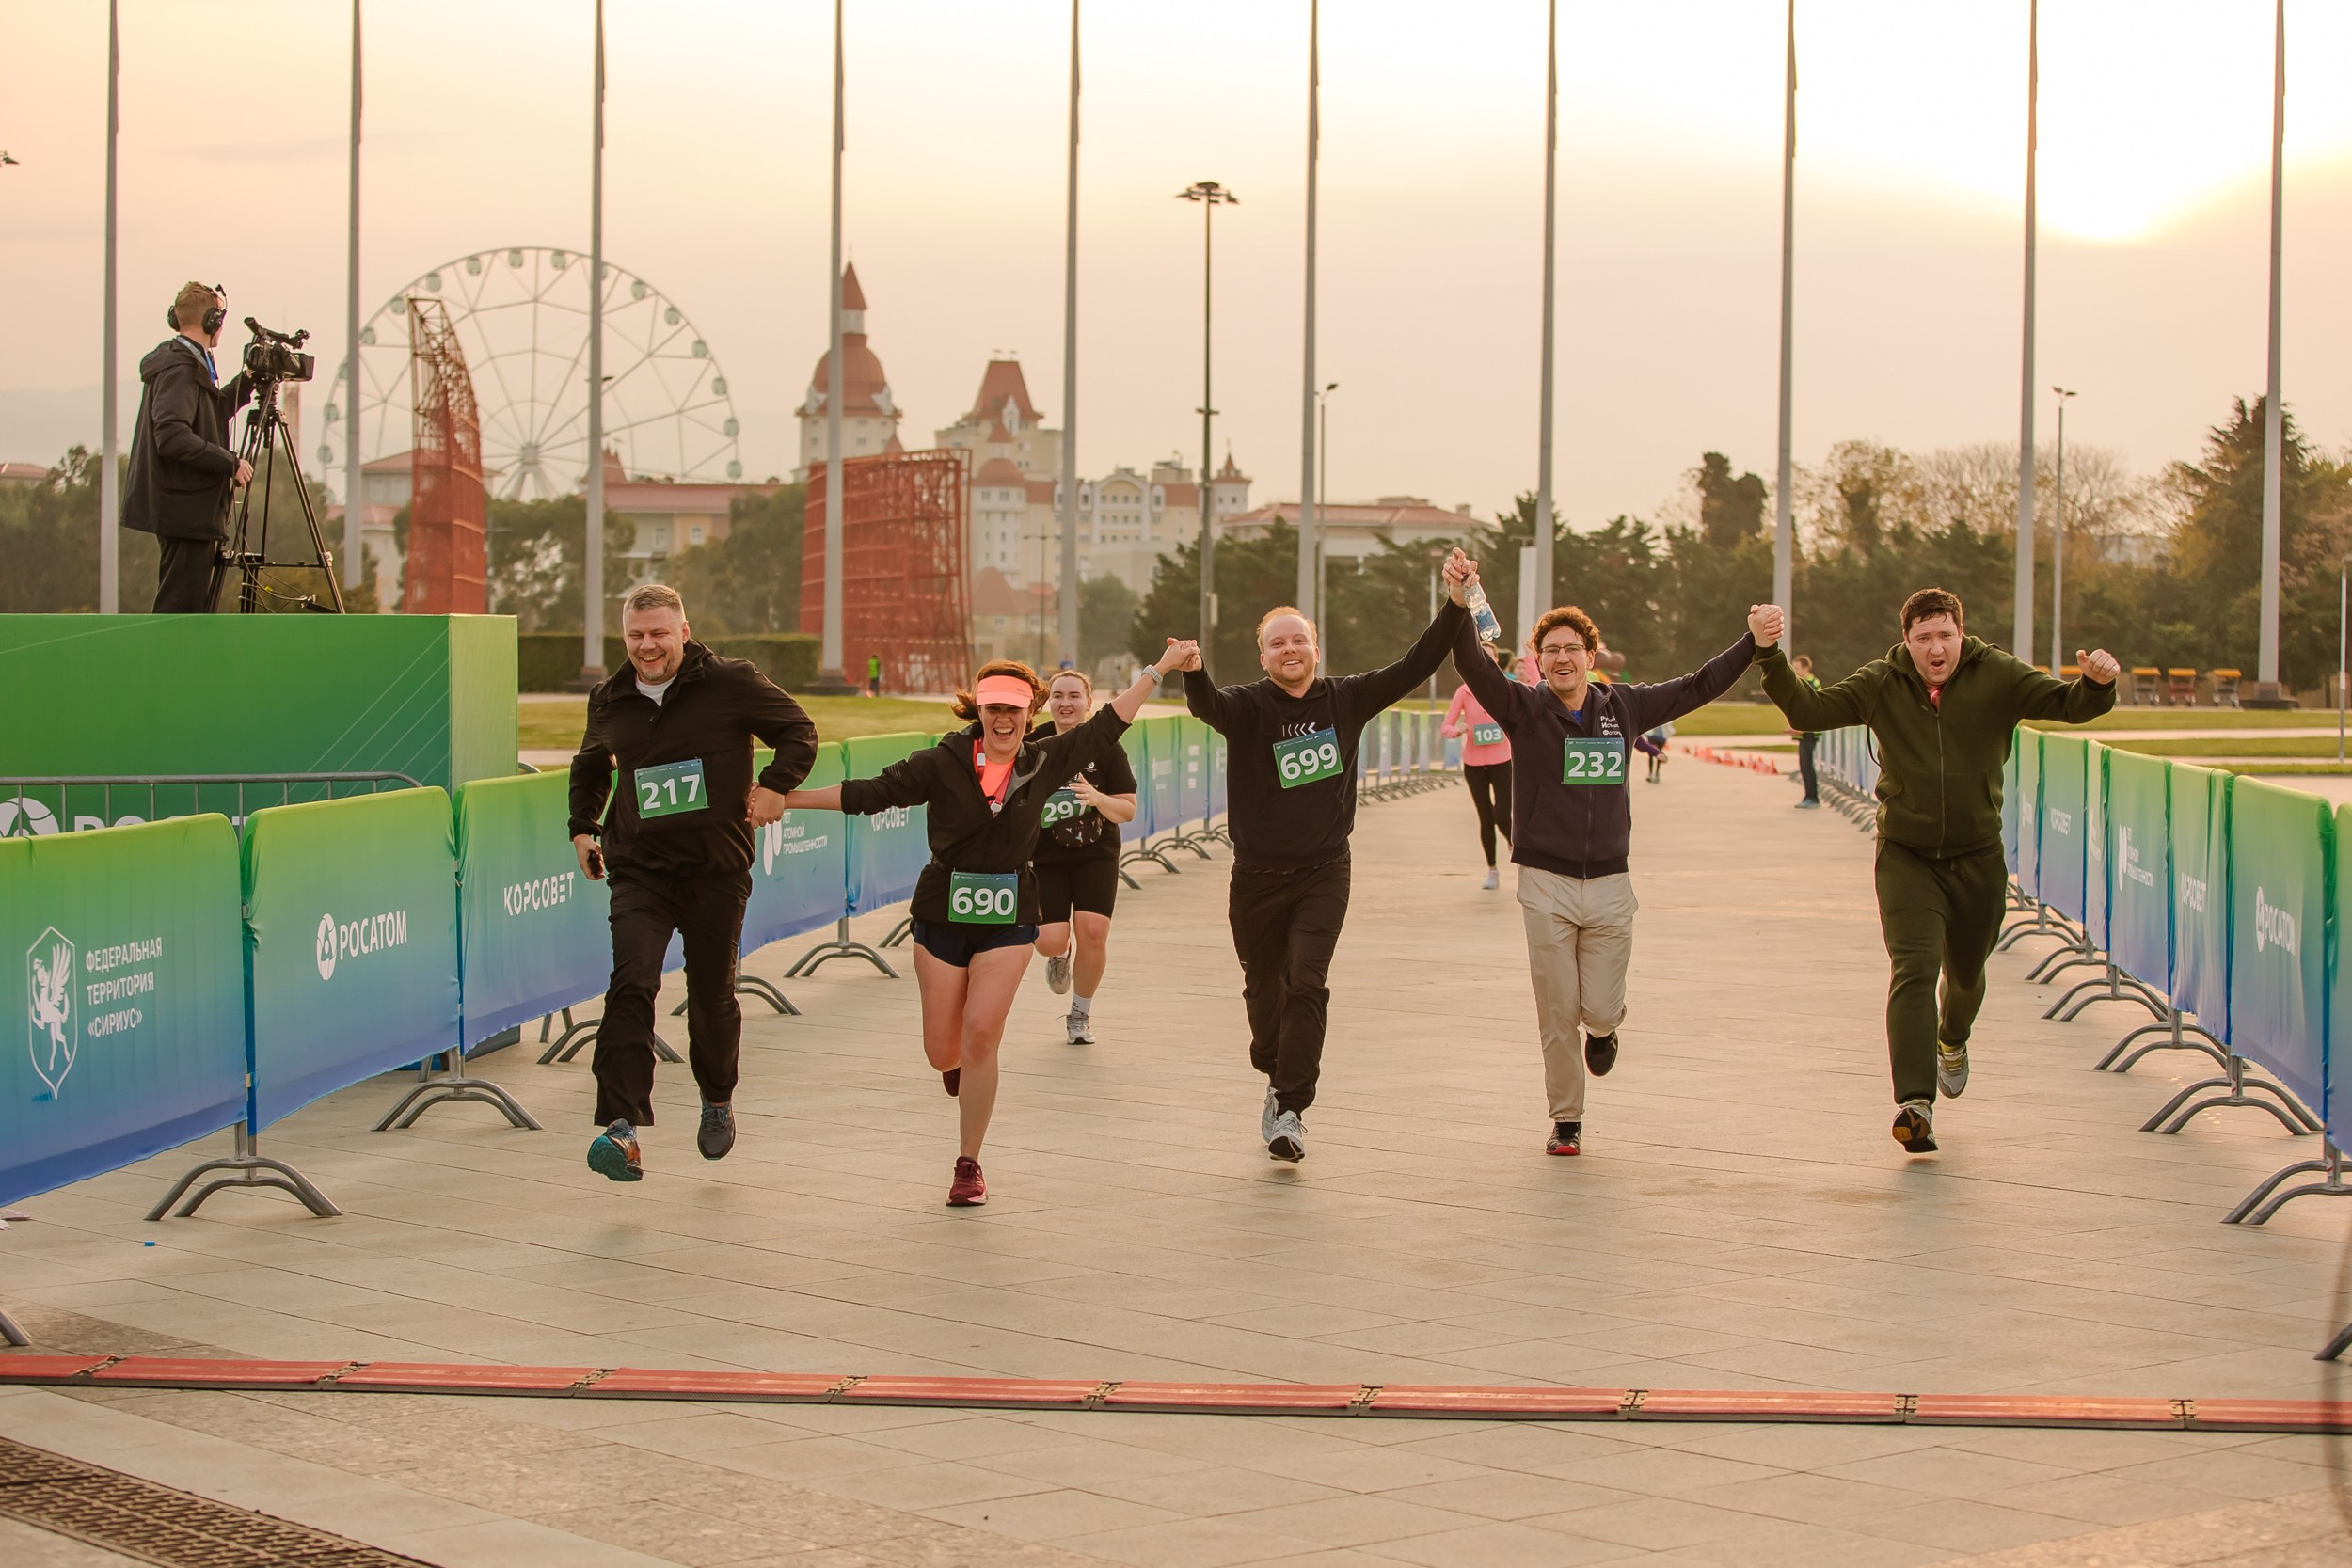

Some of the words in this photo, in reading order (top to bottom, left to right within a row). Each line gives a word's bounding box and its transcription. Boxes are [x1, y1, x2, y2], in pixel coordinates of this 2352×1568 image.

[1474, 728, 1502, 742] 103
[1280, 743, 1338, 780] 699
[1567, 751, 1622, 778] 232
[641, 774, 700, 810] 217
[1043, 799, 1088, 823] 297
[503, 871, 575, 916] КОРСОВЕТ
[952, 887, 1015, 916] 690
[340, 910, 407, 960] РОСАТОМ
[86, 937, 162, 973] ФЕДЕРАЛЬНАЯ
[87, 972, 154, 1006] ТЕРРИТОРИЯ
[87, 1008, 142, 1037] «СИРИУС»
